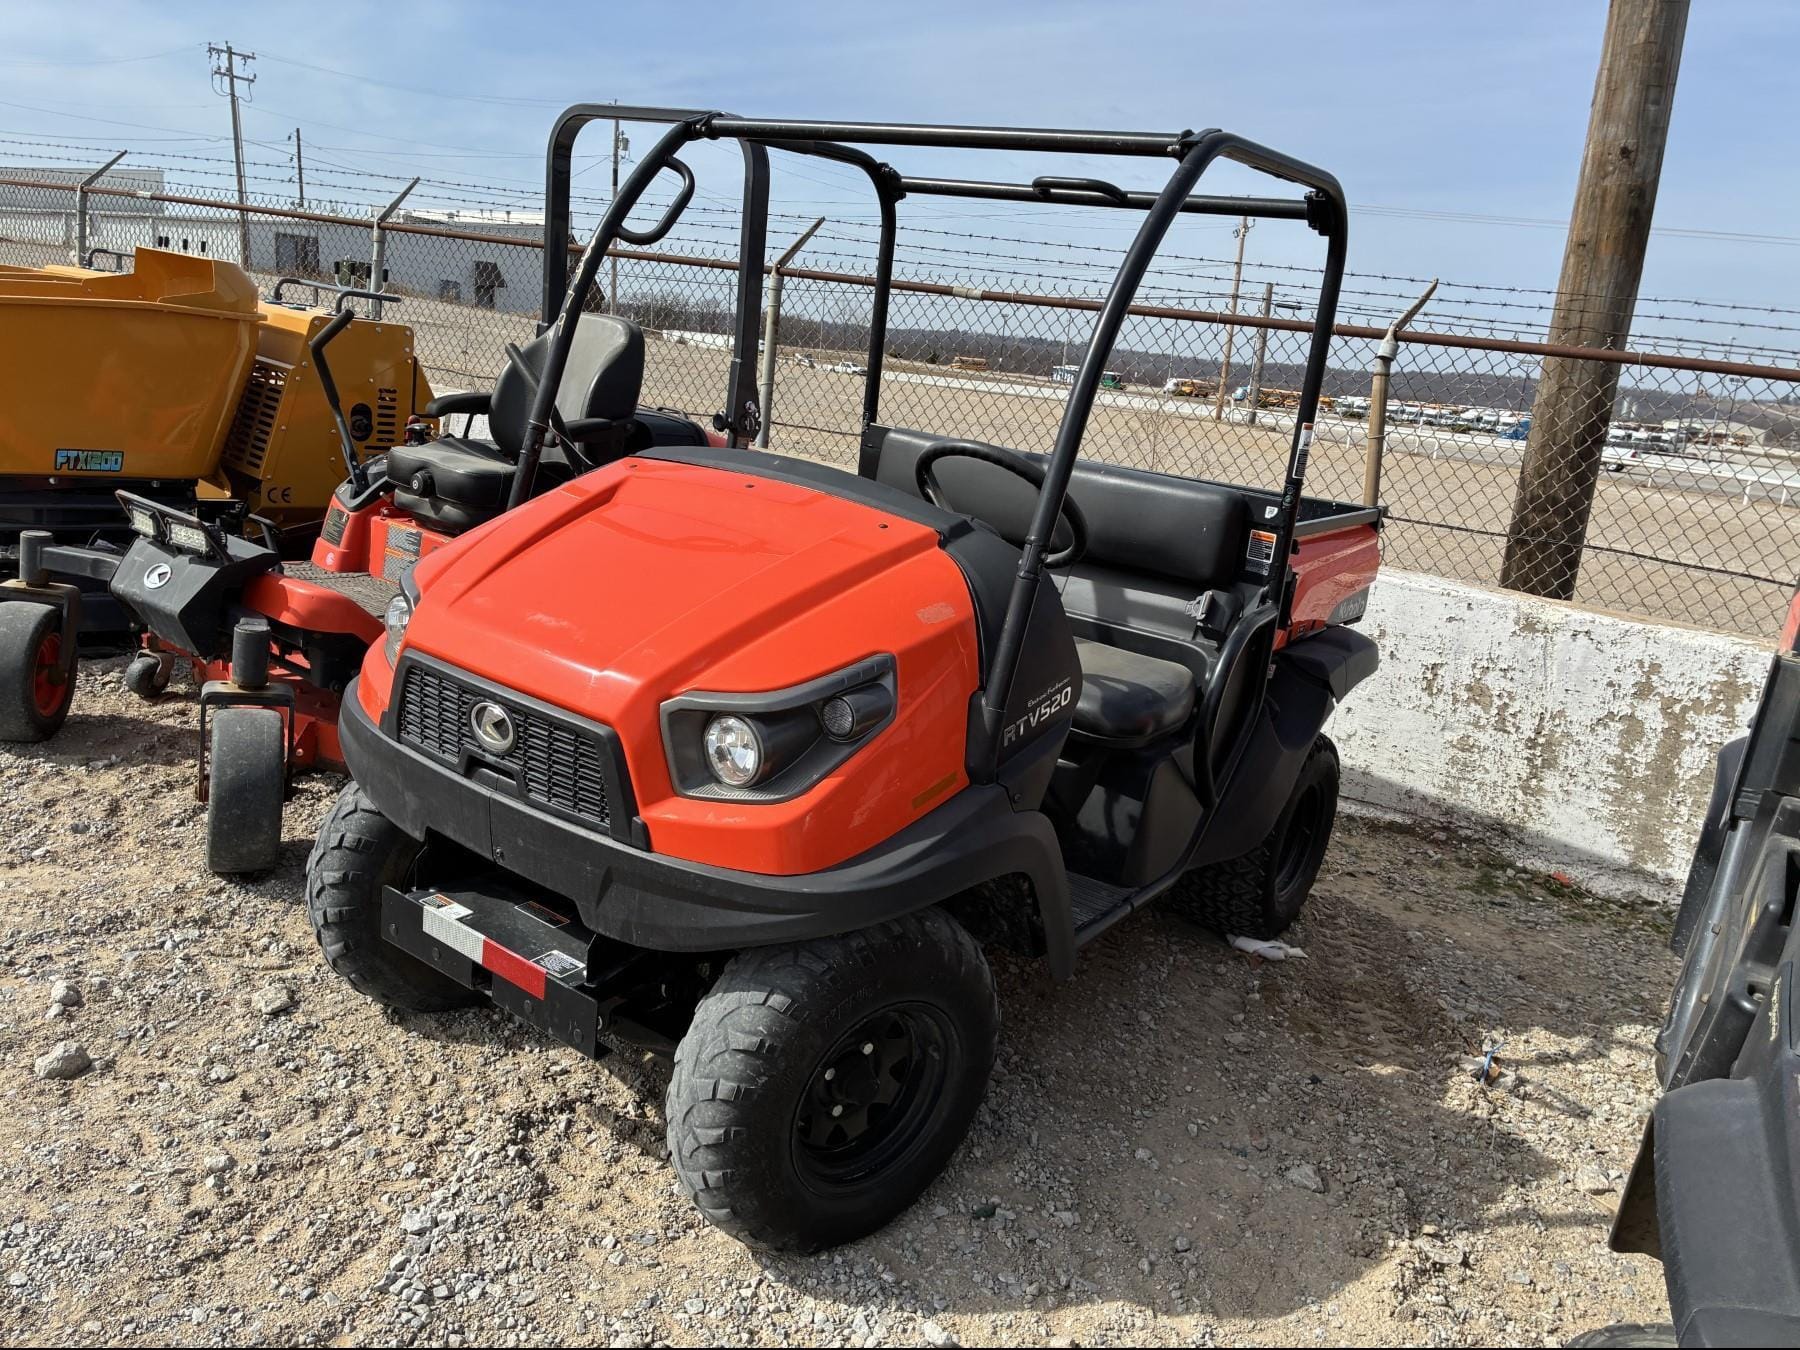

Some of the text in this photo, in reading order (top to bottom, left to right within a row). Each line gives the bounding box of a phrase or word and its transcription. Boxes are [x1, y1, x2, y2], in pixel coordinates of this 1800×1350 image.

[56, 450, 122, 471] FTX1200
[267, 487, 291, 504] CE
[1003, 686, 1072, 747] RTV520
